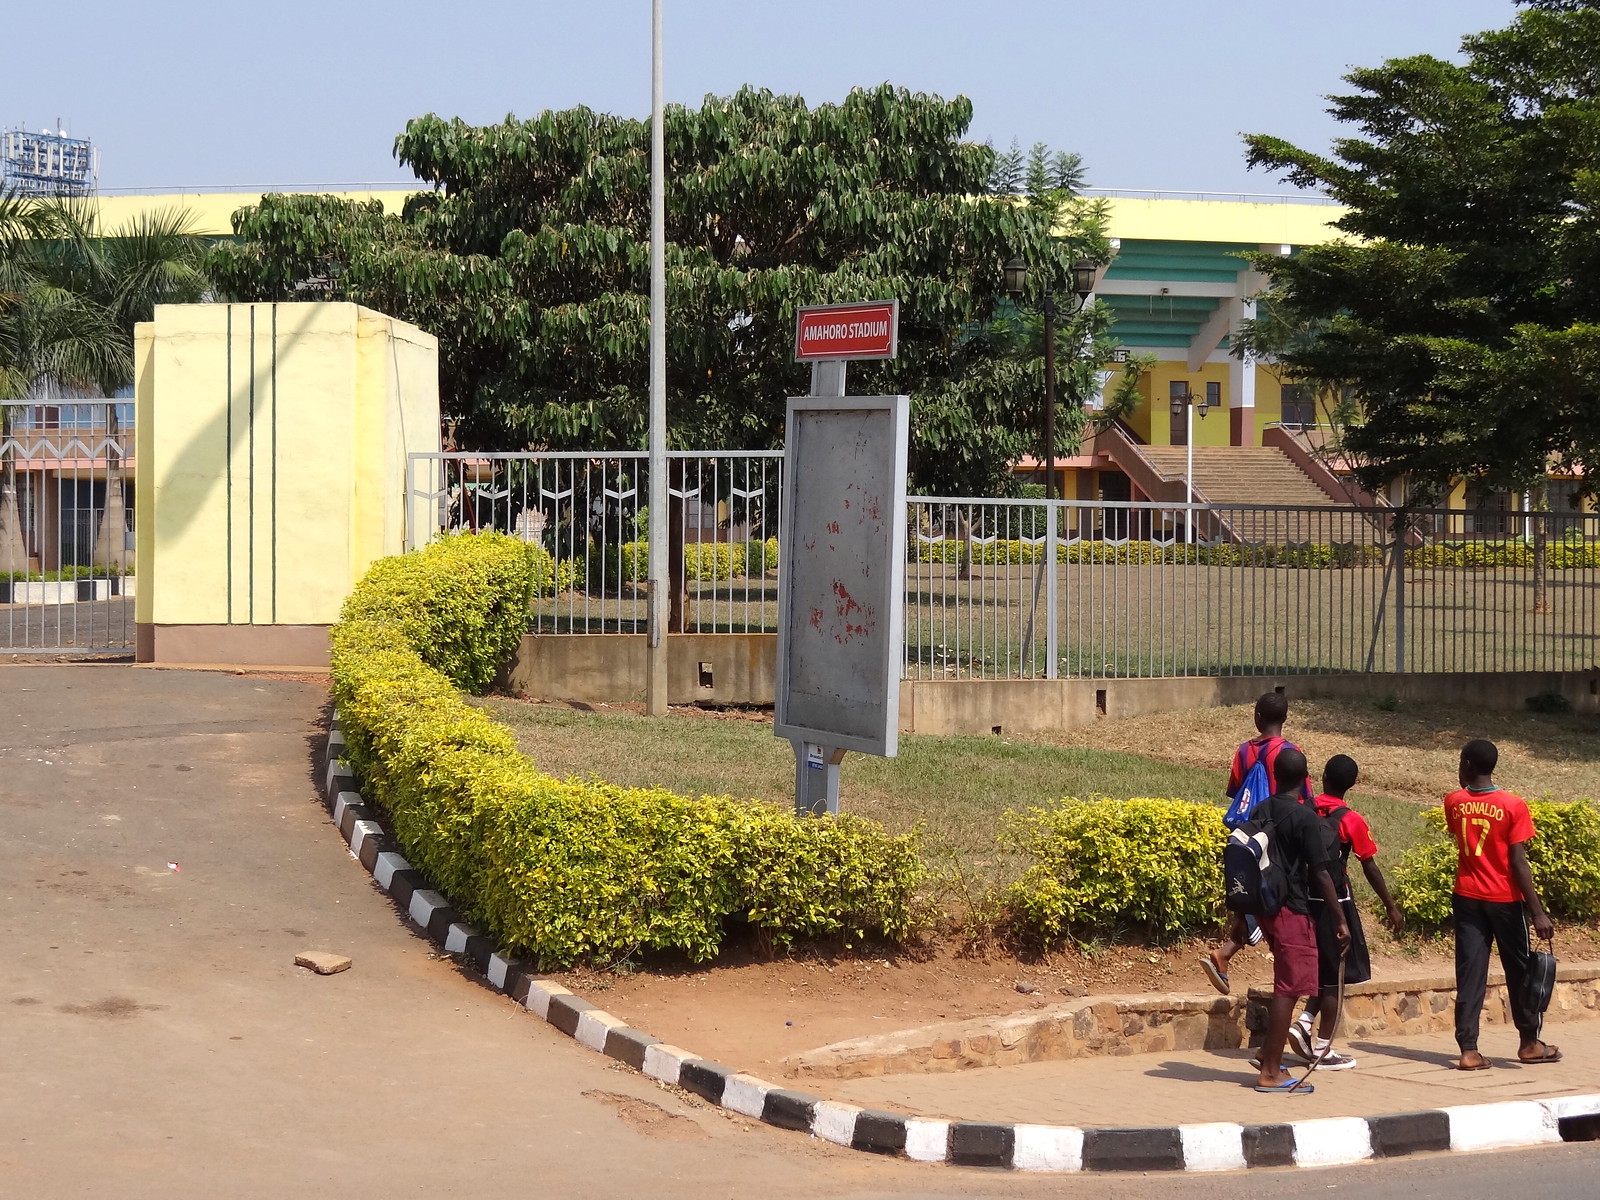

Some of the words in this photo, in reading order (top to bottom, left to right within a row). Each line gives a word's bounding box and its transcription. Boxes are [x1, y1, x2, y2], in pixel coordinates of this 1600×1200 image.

[804, 324, 847, 341] AMAHORO
[849, 321, 887, 339] STADIUM
[1461, 817, 1490, 856] 17
